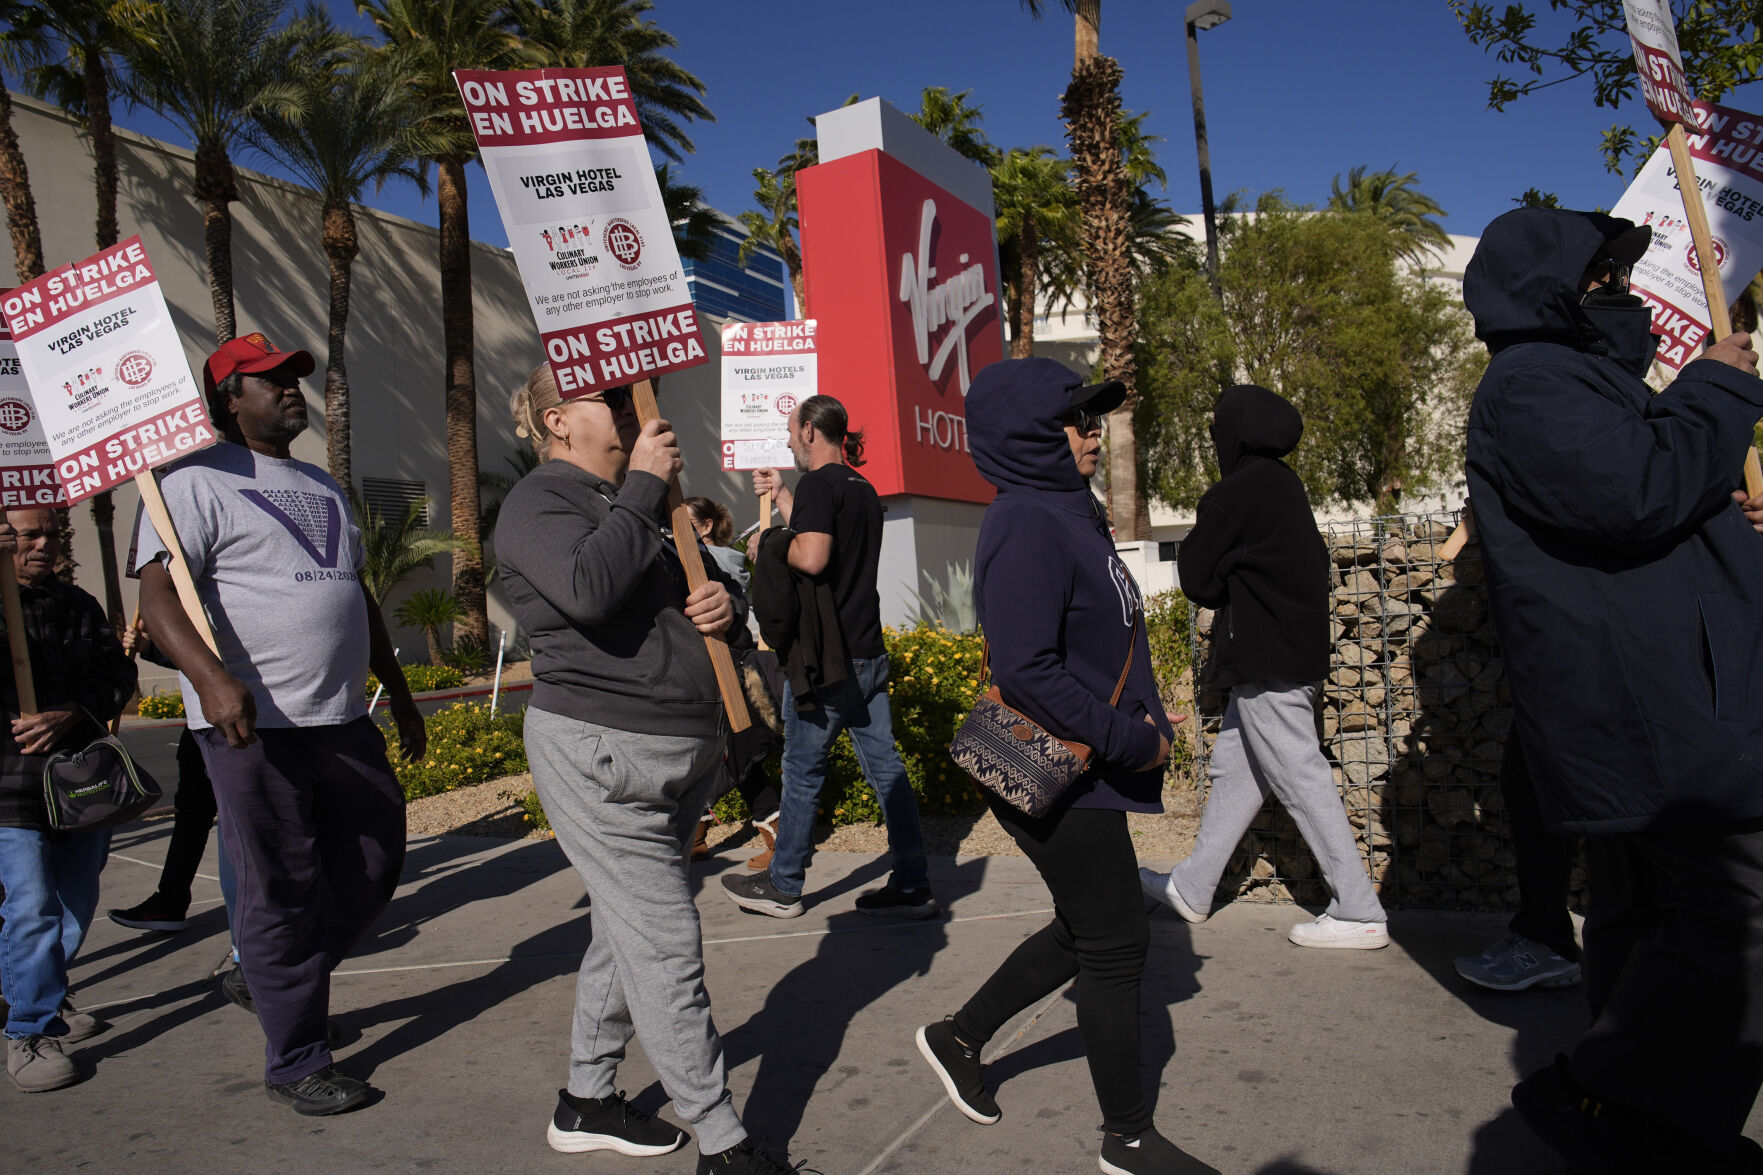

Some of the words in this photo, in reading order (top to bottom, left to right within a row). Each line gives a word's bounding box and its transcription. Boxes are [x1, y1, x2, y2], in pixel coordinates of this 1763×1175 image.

[463, 81, 510, 107] ON
[515, 75, 629, 106] STRIKE
[472, 112, 515, 136] EN
[518, 104, 636, 135] HUELGA
[1685, 132, 1710, 150] N
[519, 171, 573, 189] VIRGIN
[576, 167, 622, 182] HOTEL
[535, 185, 565, 199] LAS
[568, 179, 615, 195] VEGAS
[1706, 191, 1755, 221] VEGAS
[549, 258, 578, 271] WORKERS
[579, 255, 599, 267] UNION
[556, 249, 585, 261] CULINARY
[1640, 258, 1660, 273] sking
[1662, 266, 1674, 278] the
[4, 287, 42, 316] ON
[47, 242, 145, 295] STRIKE
[535, 295, 550, 305] We
[551, 293, 565, 302] are
[566, 289, 581, 300] not
[582, 283, 610, 298] asking
[611, 281, 625, 292] the
[626, 274, 668, 289] employees
[669, 271, 678, 281] of
[1633, 265, 1665, 284] mployer
[1665, 279, 1675, 288] to
[1674, 284, 1691, 300] stop
[10, 307, 45, 335] EN
[48, 264, 152, 317] HUELGA
[545, 306, 561, 316] any
[562, 301, 585, 313] other
[585, 293, 624, 308] employer
[626, 291, 634, 300] to
[635, 288, 651, 298] stop
[652, 284, 674, 295] work.
[900, 199, 994, 396] Virgin
[48, 325, 90, 351] VIRGIN
[93, 306, 137, 330] HOTEL
[753, 325, 815, 339] STRIKE
[1631, 289, 1705, 348] TRIKE
[60, 338, 83, 355] LAS
[86, 317, 129, 341] VEGAS
[548, 333, 591, 363] ON
[596, 310, 698, 352] STRIKE
[723, 341, 745, 352] EN
[750, 338, 815, 352] HUELGA
[556, 363, 596, 392] EN
[599, 337, 705, 381] HUELGA
[734, 367, 766, 375] VIRGIN
[769, 365, 805, 374] HOTELS
[764, 372, 795, 380] VEGAS
[52, 431, 66, 441] We
[67, 426, 80, 435] are
[81, 417, 94, 429] not
[95, 404, 119, 422] asking
[120, 399, 133, 411] the
[134, 381, 177, 404] employees
[178, 375, 187, 384] of
[92, 386, 110, 399] UNION
[60, 437, 75, 446] any
[77, 426, 96, 439] other
[97, 409, 131, 429] employer
[133, 403, 141, 412] to
[143, 395, 160, 408] stop
[161, 388, 182, 400] work.
[2, 448, 11, 456] to
[13, 447, 32, 458] stop
[5, 440, 48, 450] employee
[60, 449, 100, 479] ON
[105, 403, 205, 459] STRIKE
[723, 443, 735, 455] O
[66, 472, 102, 499] EN
[107, 425, 212, 481] HUELGA
[724, 456, 734, 468] E
[301, 491, 326, 499] VIEW
